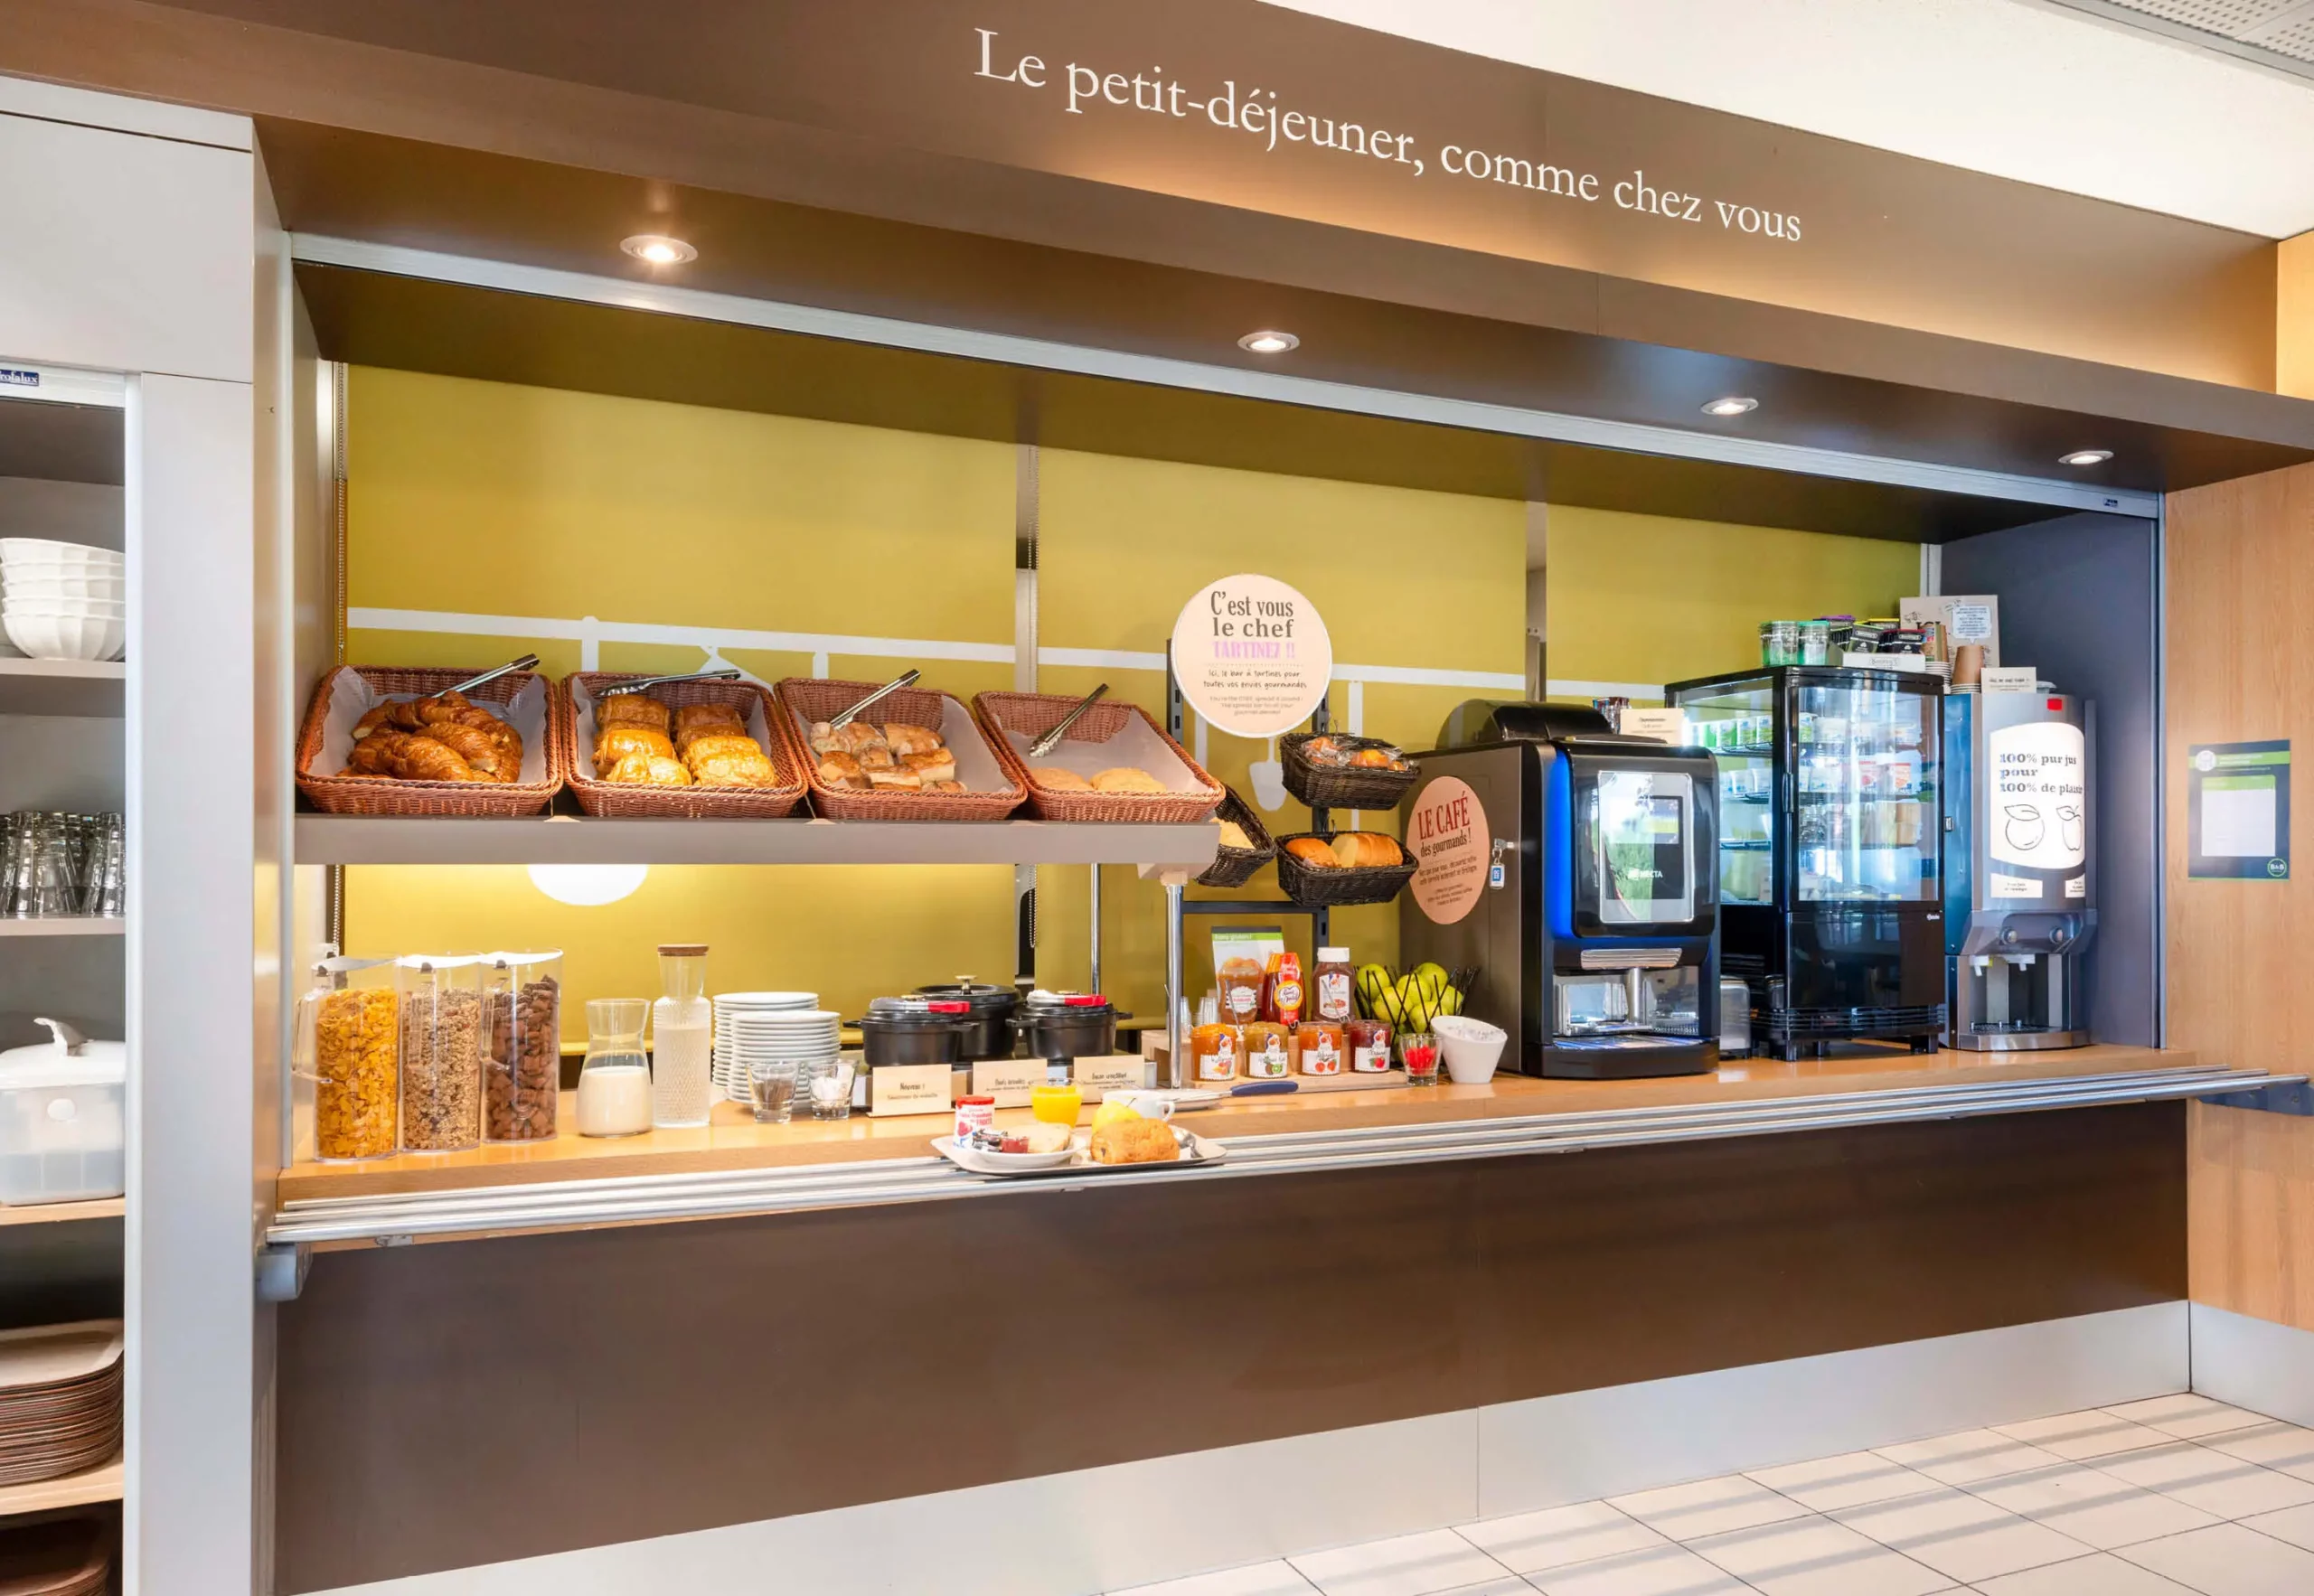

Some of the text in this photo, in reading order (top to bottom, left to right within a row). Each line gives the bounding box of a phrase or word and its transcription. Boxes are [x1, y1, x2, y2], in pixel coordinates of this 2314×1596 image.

[974, 28, 1802, 242] Le petit-déjeuner, comme chez vous
[0, 370, 38, 383] rofalux
[1211, 590, 1293, 617] C'est vous
[1213, 616, 1294, 637] le chef
[1213, 641, 1281, 659] TARTINEZ
[1284, 671, 1301, 680] pour
[1265, 680, 1307, 690] gourmandes
[1999, 754, 2077, 766] 100% pur jus
[1999, 769, 2038, 779] pour
[1999, 783, 2037, 793] 100%
[2041, 783, 2056, 793] de
[1417, 790, 1471, 840] LE CAFÉ
[1420, 841, 1431, 858] des
[1432, 829, 1468, 858] gourmands
